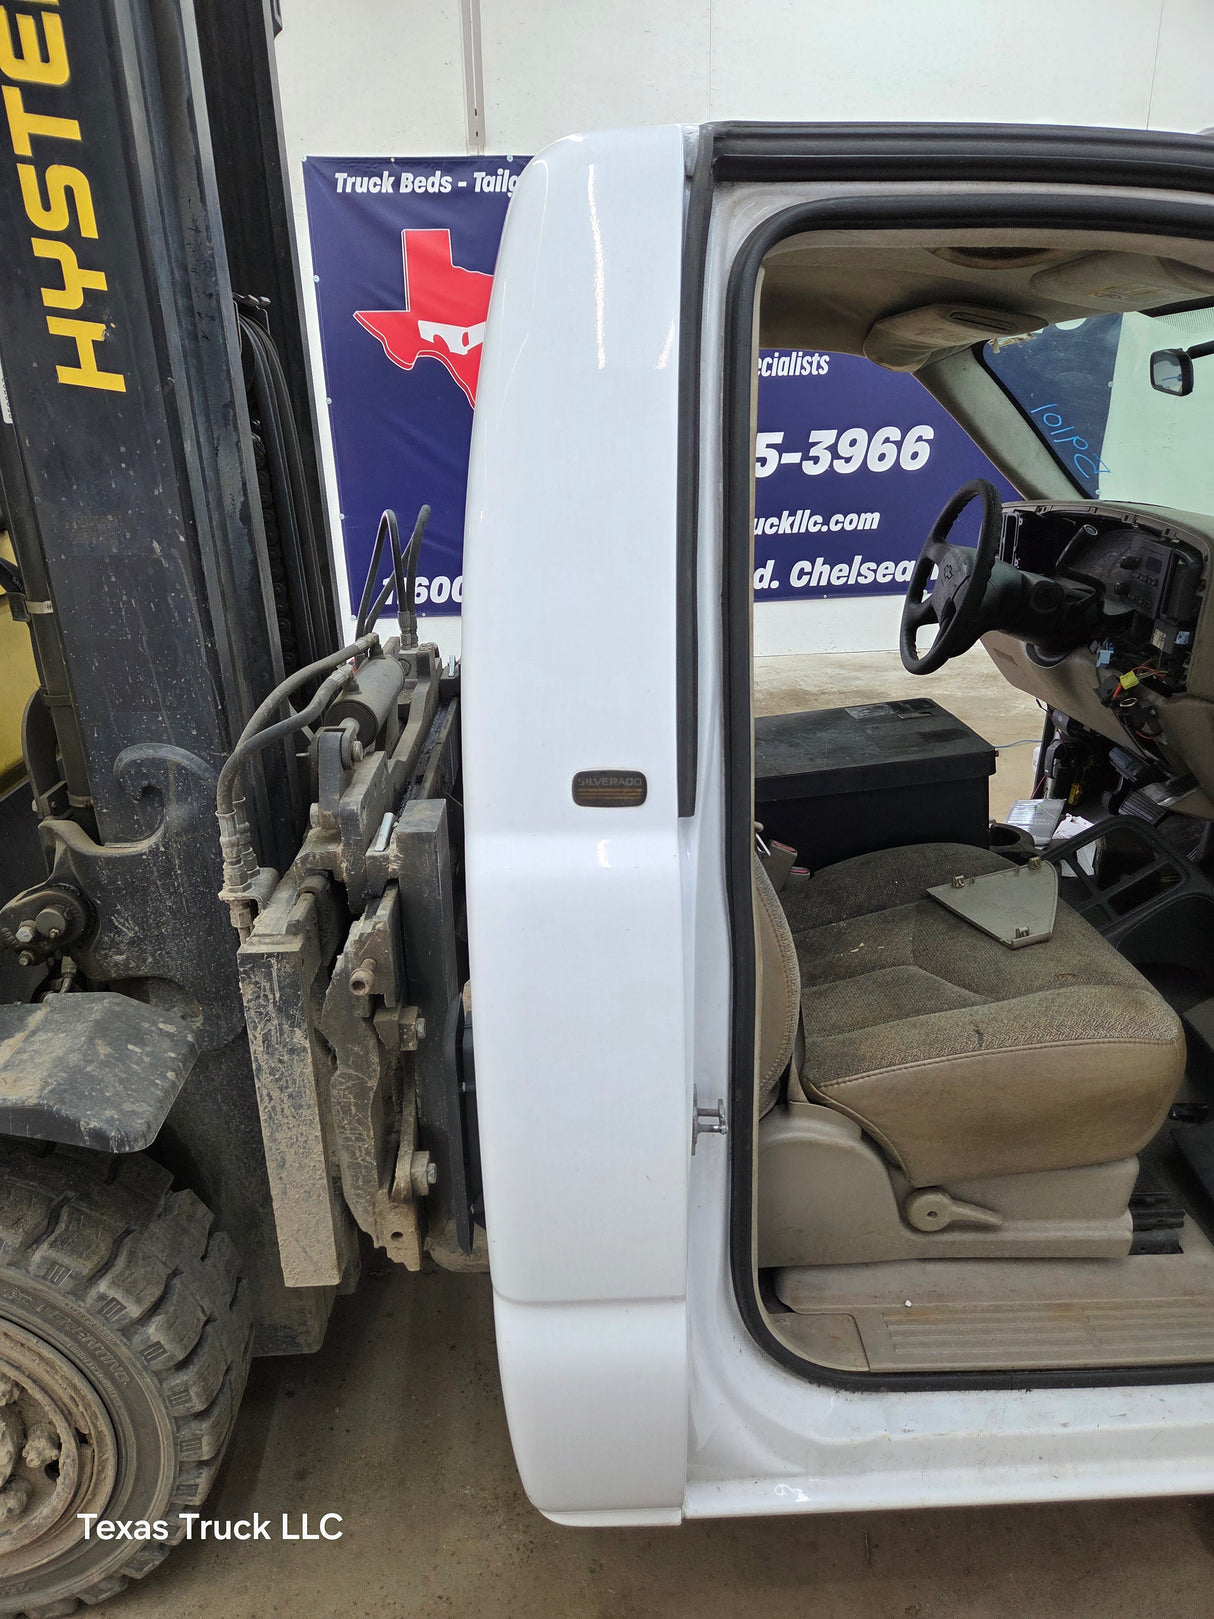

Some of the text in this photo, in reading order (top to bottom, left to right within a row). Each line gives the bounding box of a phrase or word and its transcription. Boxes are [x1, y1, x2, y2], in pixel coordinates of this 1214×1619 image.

[335, 171, 396, 193] Truck
[399, 170, 453, 193] Beds
[0, 0, 127, 393] HYSTE
[755, 424, 935, 478] 5-3966
[753, 509, 881, 535] uckllc.com
[577, 776, 643, 787] SILVERADO
